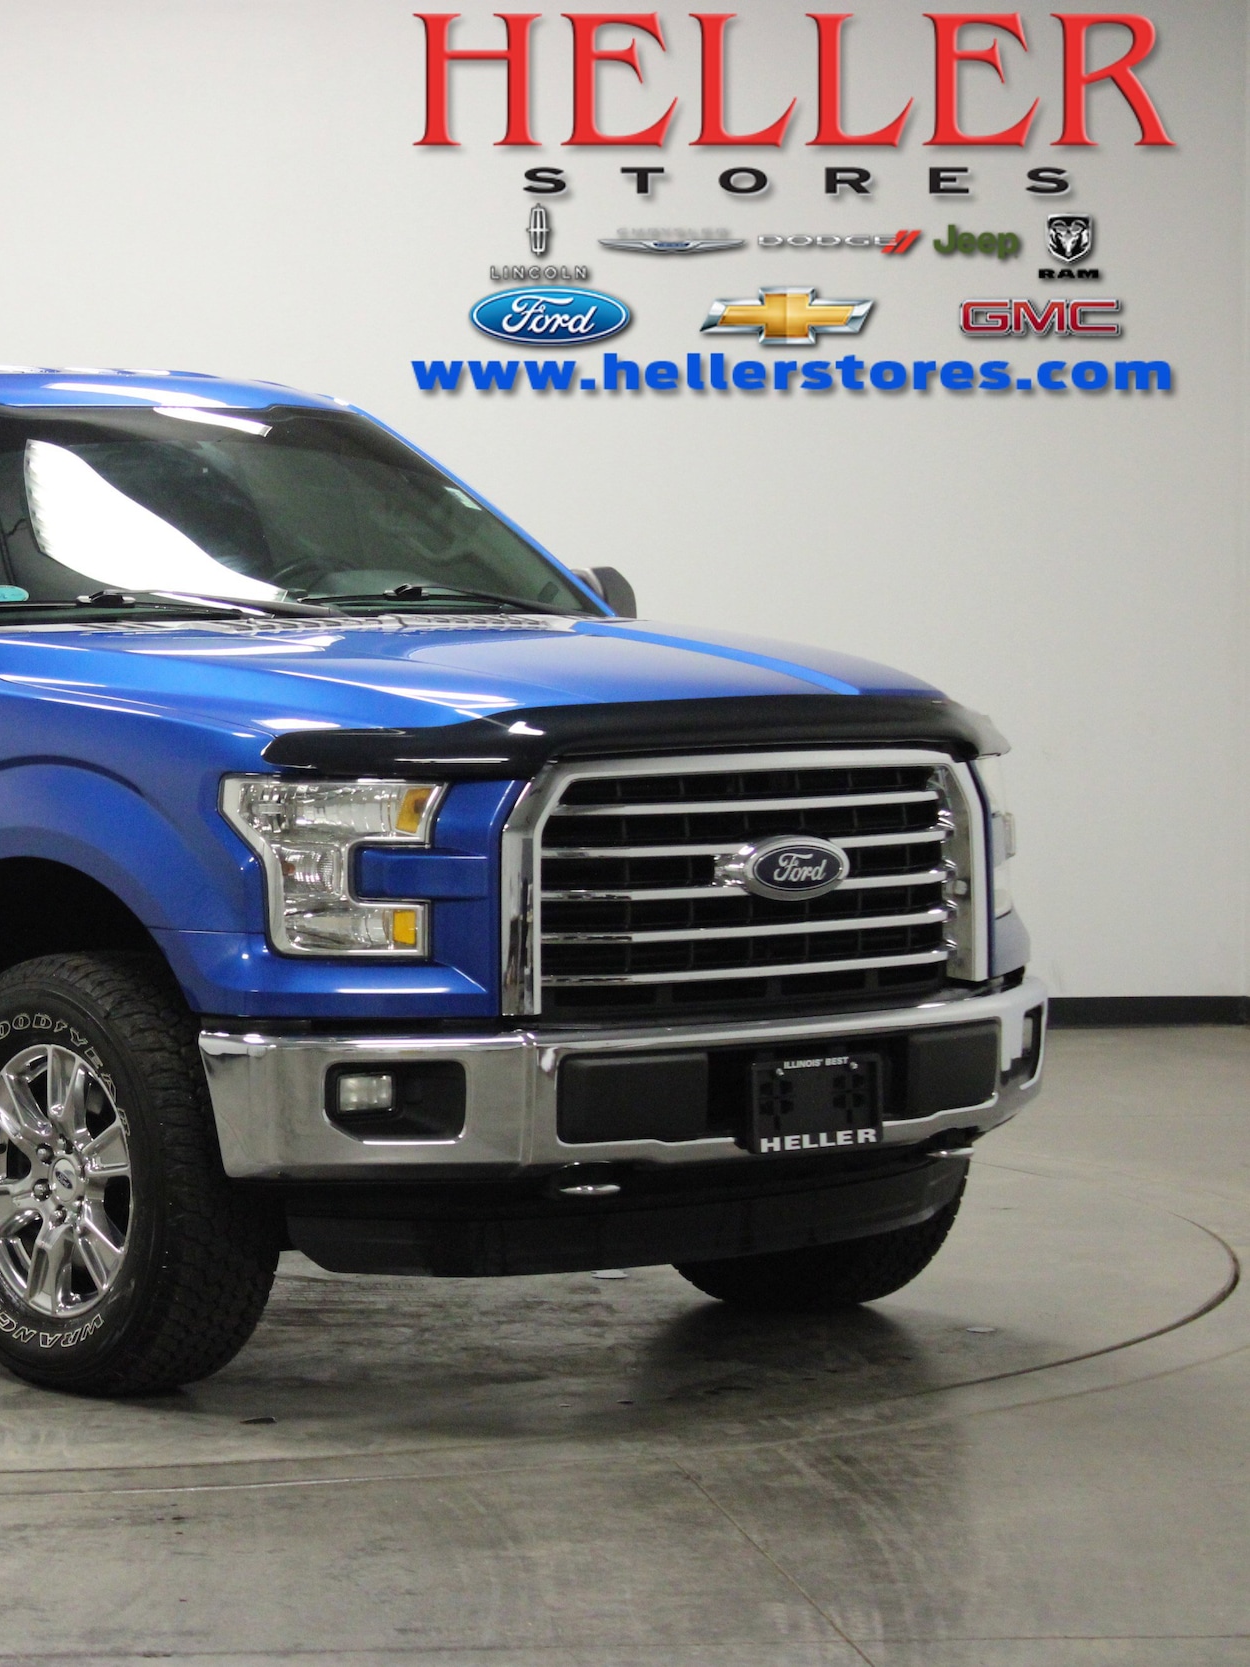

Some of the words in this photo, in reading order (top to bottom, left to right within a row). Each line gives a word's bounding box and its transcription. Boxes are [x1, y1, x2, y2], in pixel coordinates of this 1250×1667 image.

[773, 852, 828, 882] Ford
[825, 1056, 850, 1066] BEST
[760, 1128, 877, 1153] HELLER
